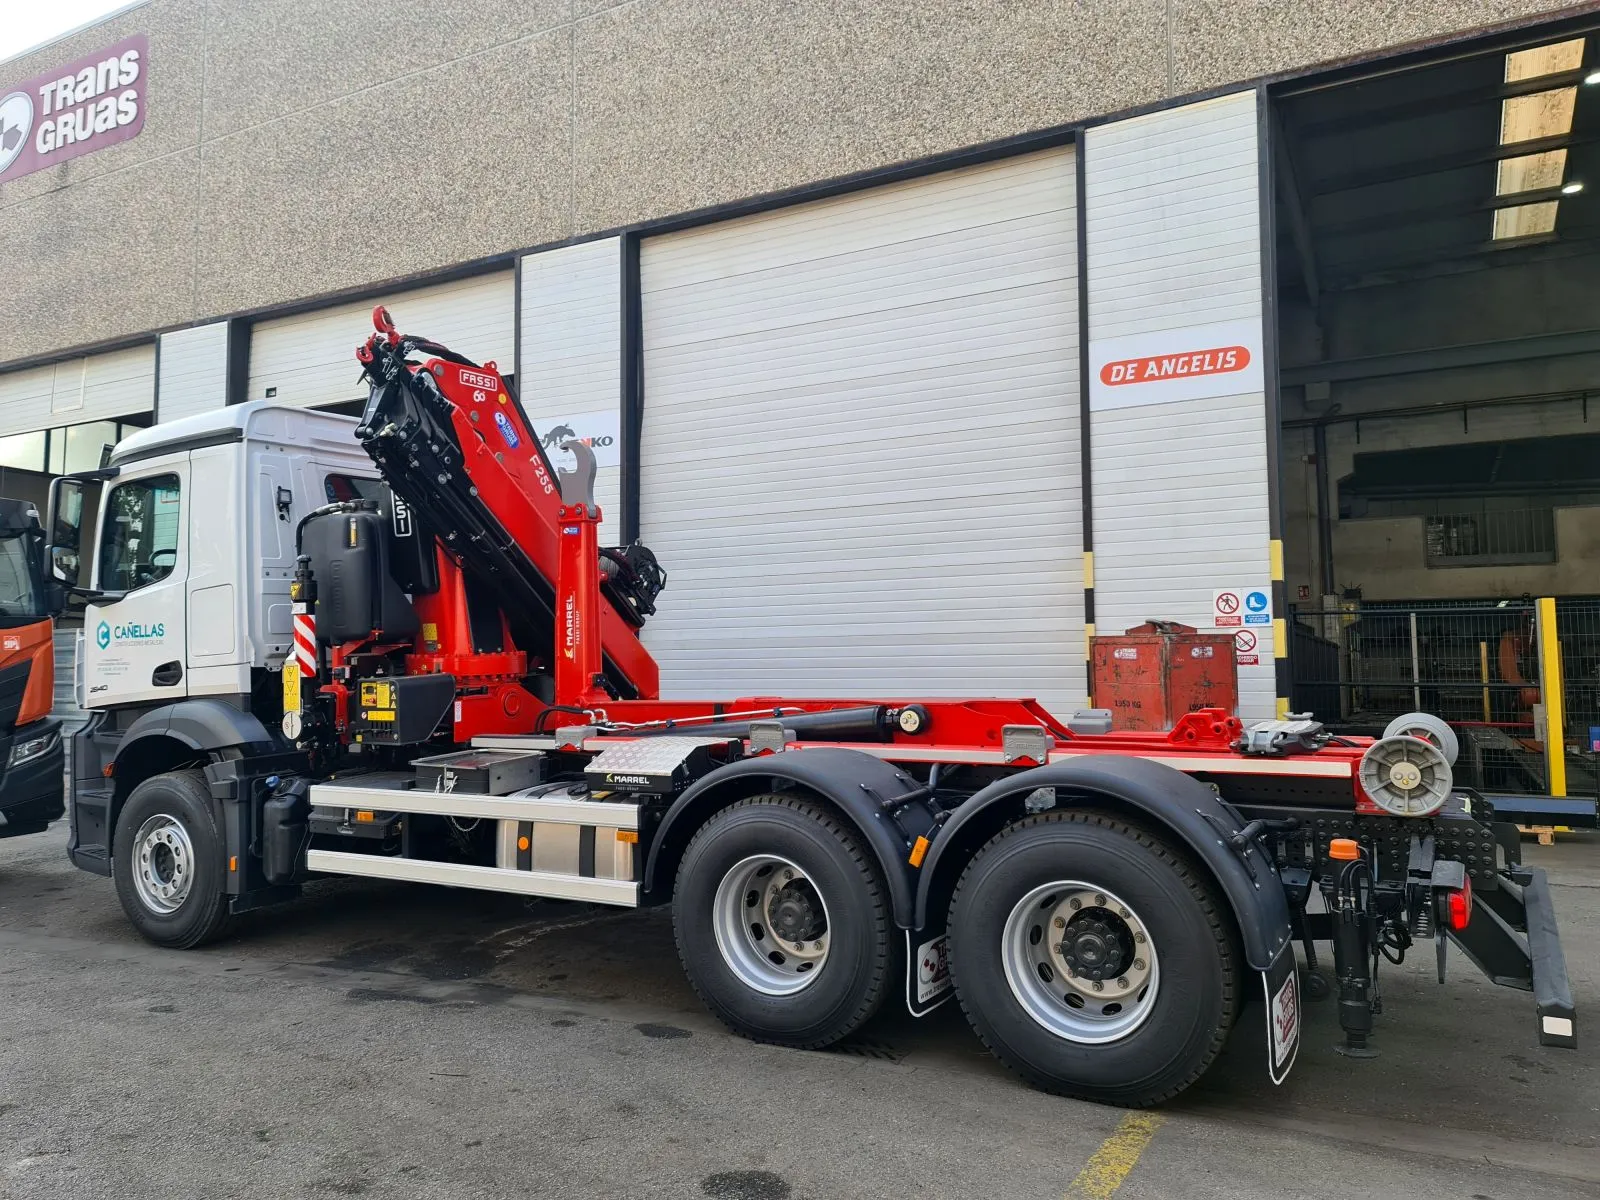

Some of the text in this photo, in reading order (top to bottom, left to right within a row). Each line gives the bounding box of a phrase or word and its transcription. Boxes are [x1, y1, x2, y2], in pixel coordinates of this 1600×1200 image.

[1110, 350, 1237, 382] DE ANGELIS
[462, 372, 494, 388] FASSI
[565, 595, 573, 646] MARREL
[114, 621, 165, 639] CAÑELLAS
[614, 775, 650, 784] MARREL
